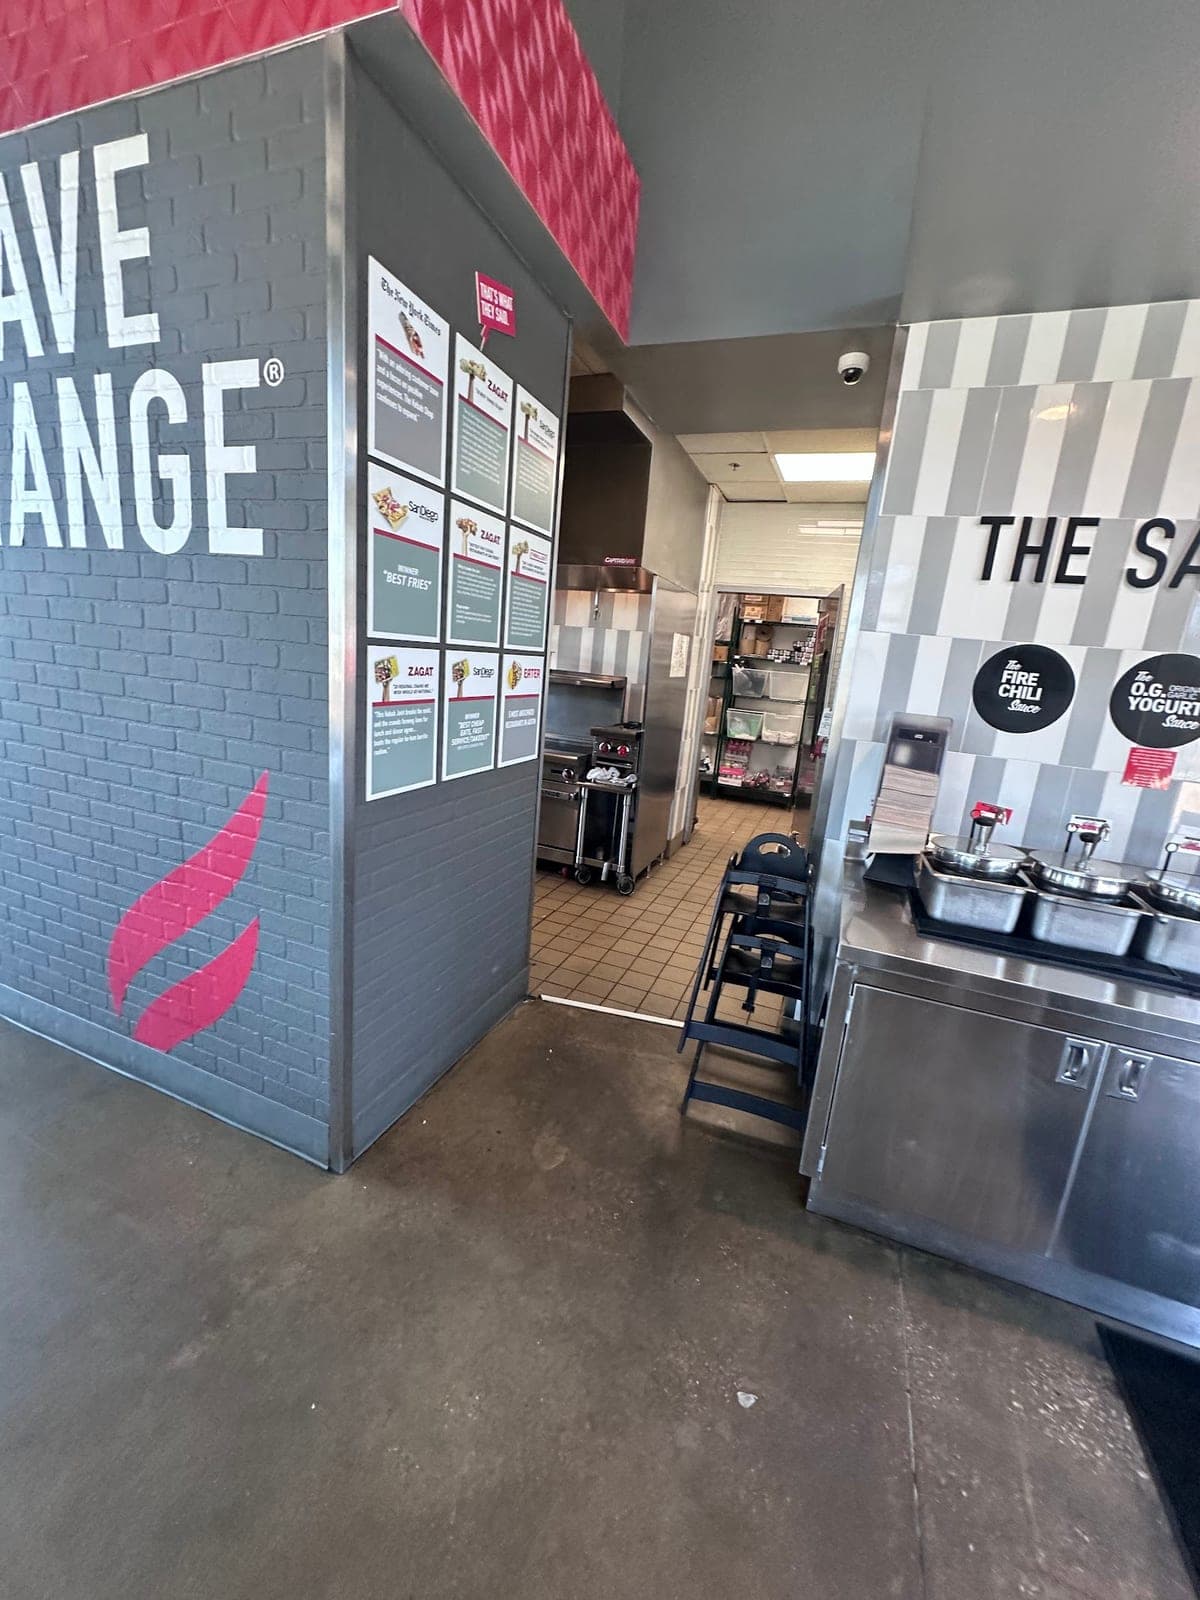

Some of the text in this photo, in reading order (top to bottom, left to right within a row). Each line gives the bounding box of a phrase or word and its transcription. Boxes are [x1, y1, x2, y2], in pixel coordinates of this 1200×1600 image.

[481, 530, 501, 545] ZAGAT
[980, 516, 1100, 585] THE
[408, 666, 434, 677] ZAGAT
[1005, 660, 1023, 670] The
[524, 668, 541, 678] EATER
[1001, 670, 1040, 686] FIRE
[1134, 670, 1155, 682] The
[998, 684, 1043, 701] CHILI
[1130, 682, 1166, 698] O.G.
[1167, 691, 1198, 700] GARLIC
[1007, 699, 1042, 714] Sauce
[1128, 696, 1200, 716] YOGURT
[1161, 714, 1200, 730] Sauce
